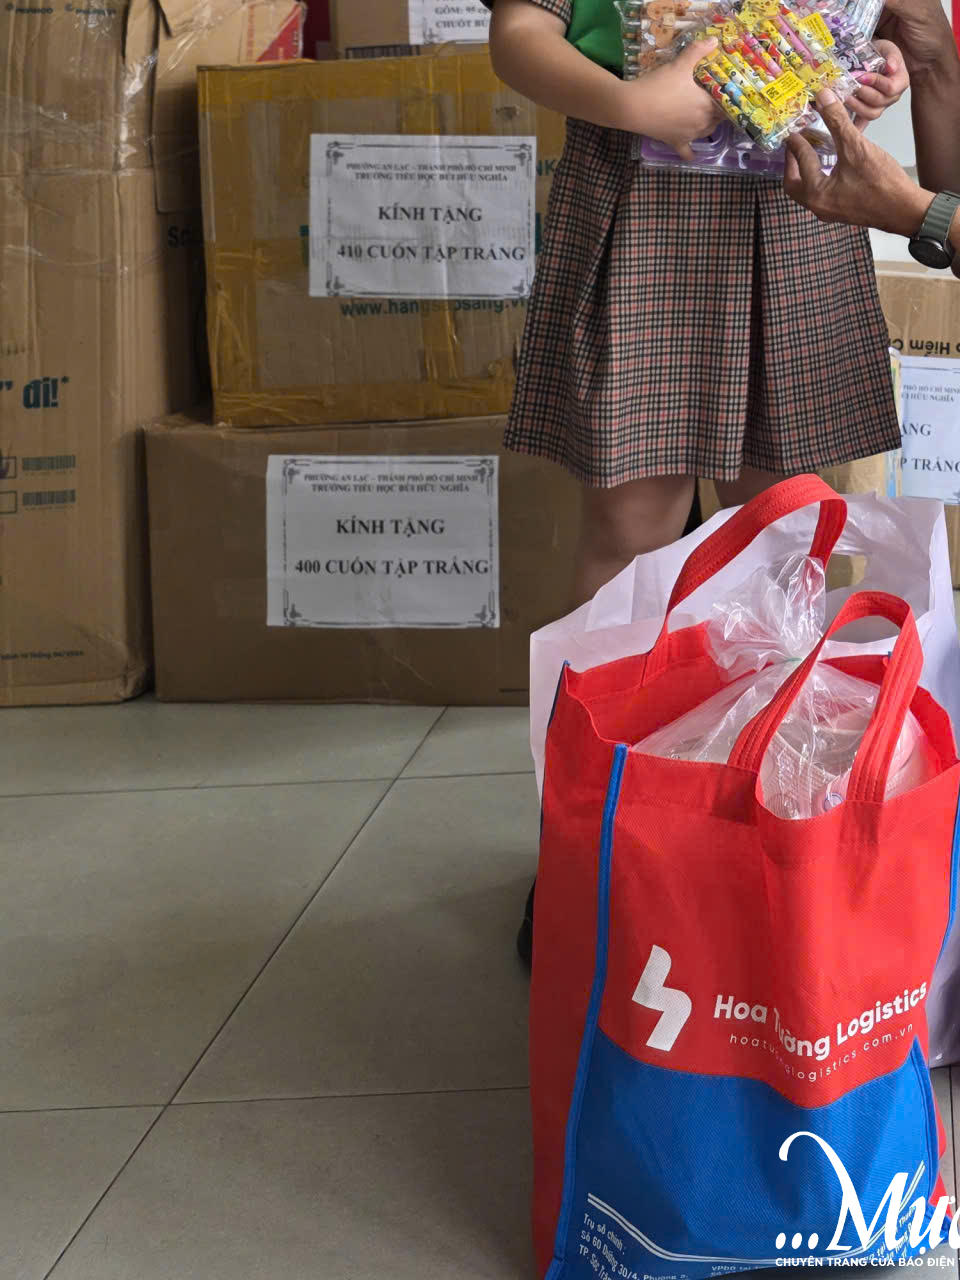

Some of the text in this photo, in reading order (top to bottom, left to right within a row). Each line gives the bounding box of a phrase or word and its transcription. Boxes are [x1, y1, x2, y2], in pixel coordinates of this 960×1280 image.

[378, 202, 483, 225] KÍNH TẶNG
[337, 242, 526, 263] 410 CUỐN TẬP TRẮNG
[336, 515, 446, 538] KÍNH TẶNG
[295, 556, 489, 579] 400 CUỐN TẬP TRẮNG
[713, 994, 768, 1024] Hoa
[836, 981, 928, 1046] Logistics
[583, 1213, 595, 1230] Trụ
[592, 1236, 602, 1250] 60
